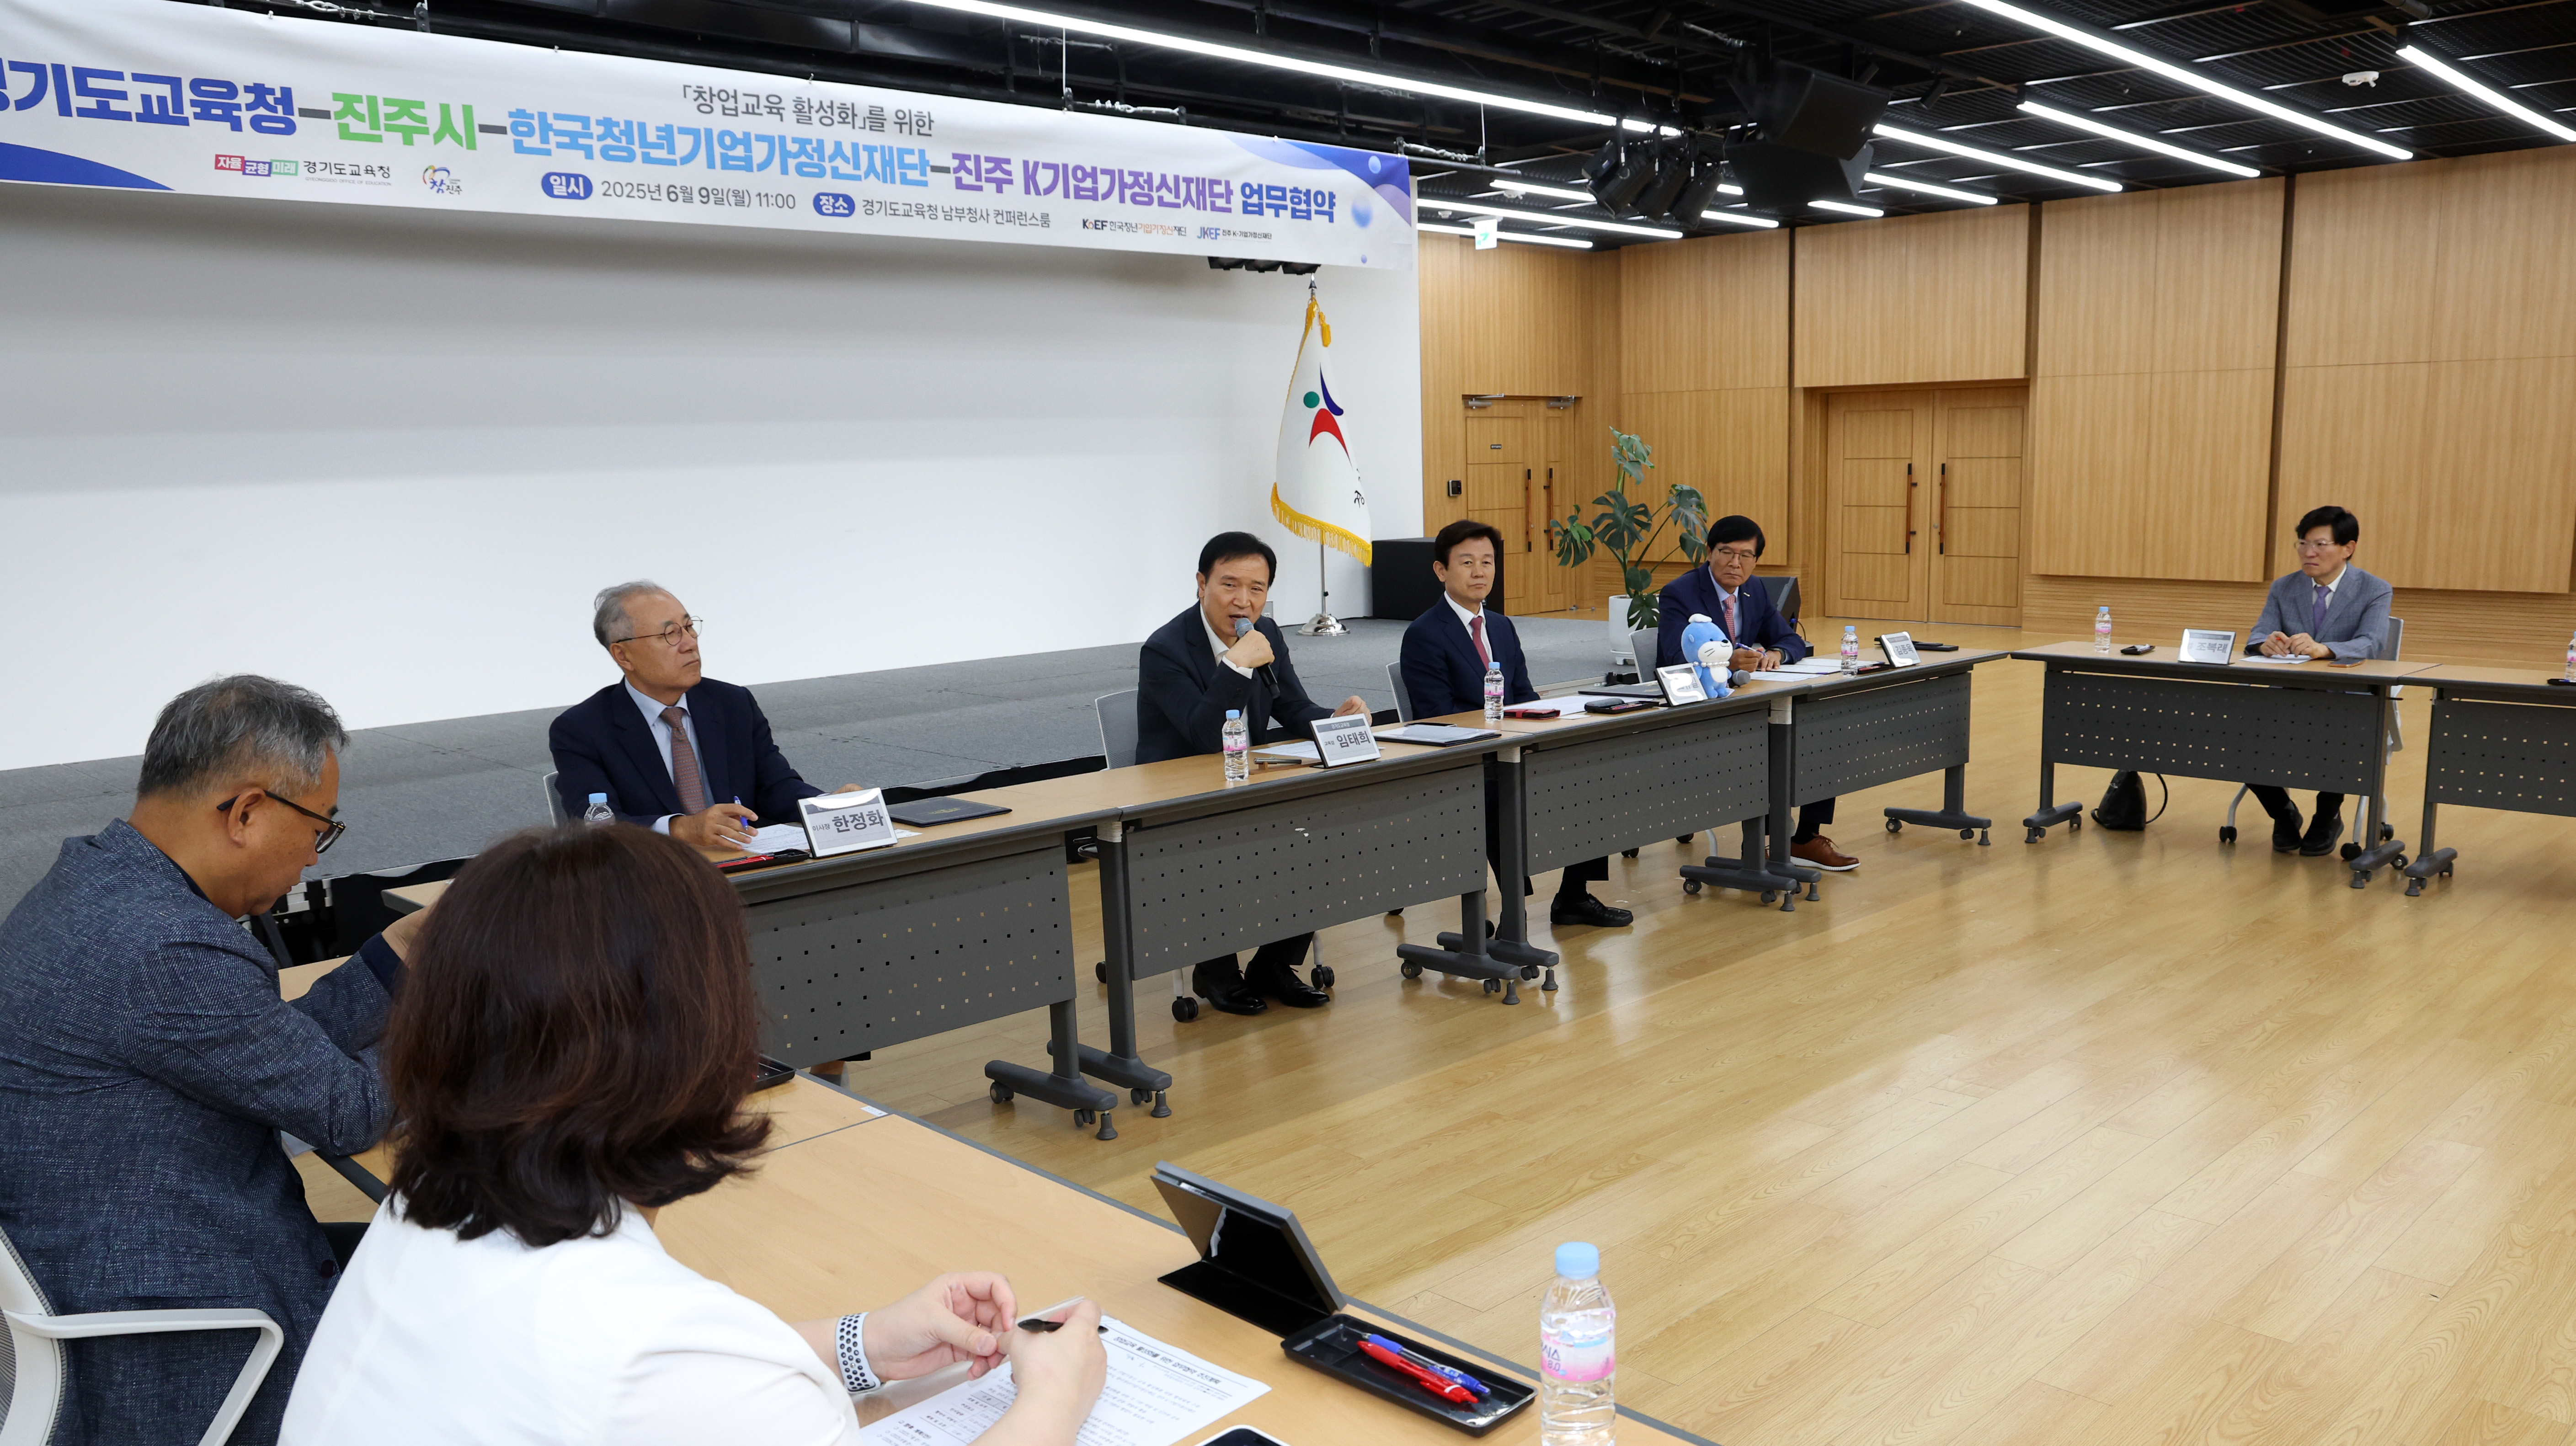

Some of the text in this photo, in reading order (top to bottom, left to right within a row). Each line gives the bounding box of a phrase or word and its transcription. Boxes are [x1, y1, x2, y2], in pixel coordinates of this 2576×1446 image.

[893, 108, 934, 137] 위한
[217, 156, 296, 175] 자율 균형 미래
[304, 160, 391, 178] 경기도교육청
[549, 175, 585, 197] 일시
[601, 181, 796, 209] 2025년 6월 9일(월) 11:00
[1023, 160, 1233, 213] K기업가정신재단
[1241, 181, 1336, 224] 업무협약
[819, 195, 850, 215] 장소
[862, 199, 1051, 228] 경기도교육청 남부청사 컨퍼런스룸
[1197, 226, 1221, 240] JKEF
[1232, 230, 1272, 239] K-기업가정신재단
[1336, 731, 1371, 748] 임태희
[812, 809, 884, 833] 이사장 한정화
